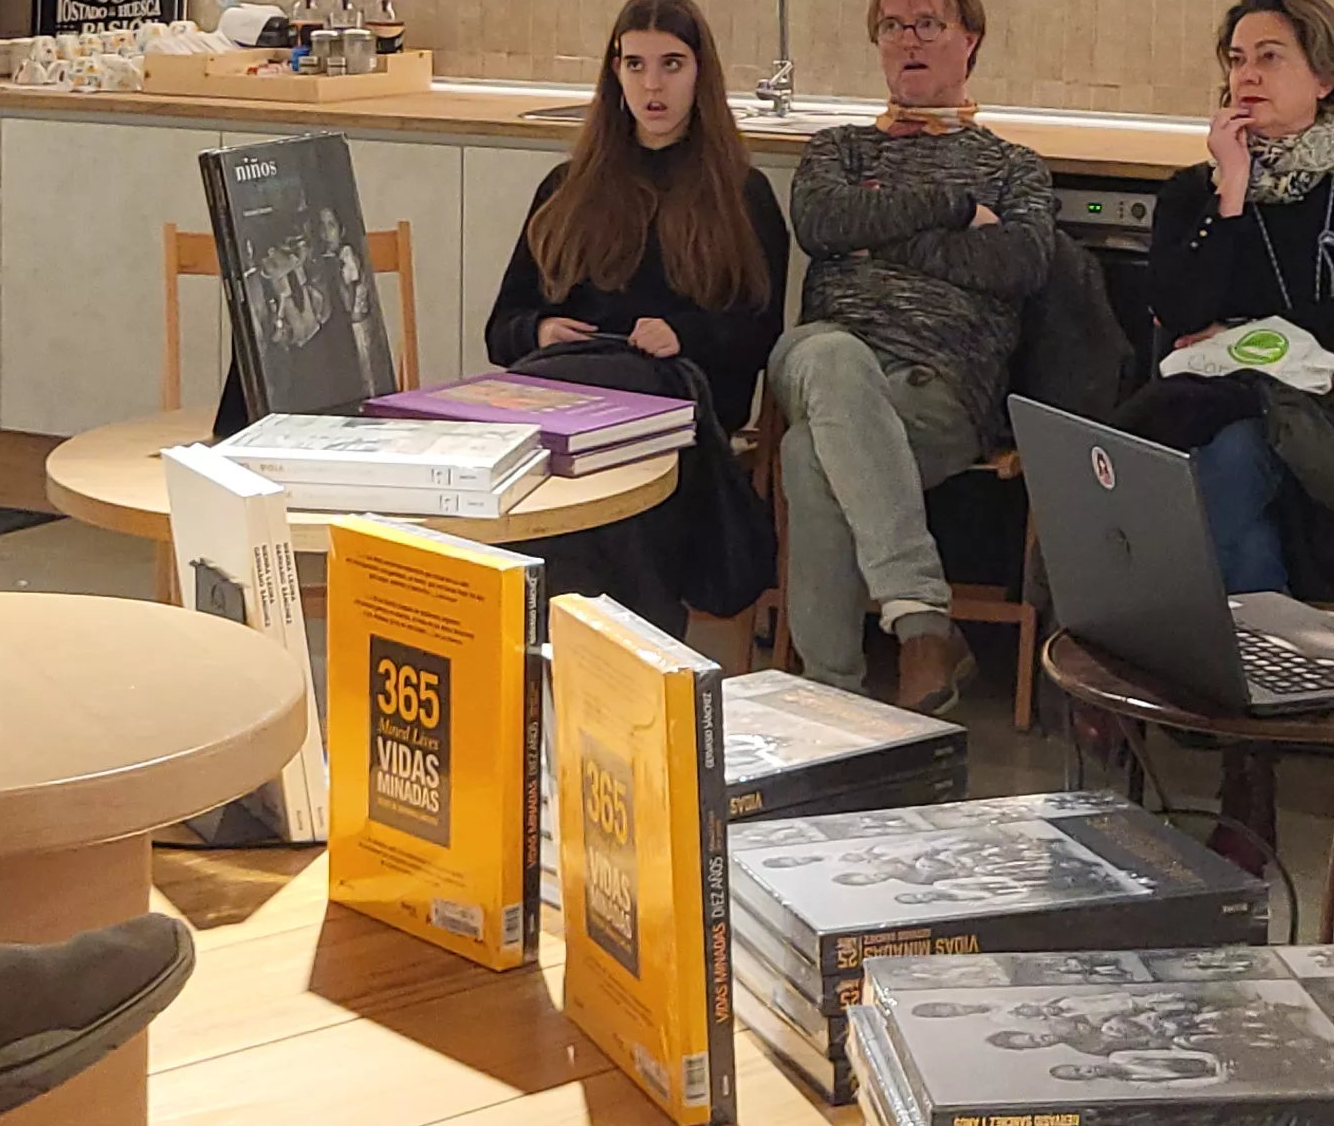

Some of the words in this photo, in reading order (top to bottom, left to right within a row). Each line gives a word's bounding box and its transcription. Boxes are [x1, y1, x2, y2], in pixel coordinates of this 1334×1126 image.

[234, 157, 278, 182] niños
[377, 657, 440, 729] 365
[376, 736, 441, 789] VIDAS
[377, 770, 441, 813] MINADAS
[586, 761, 628, 846] 365
[588, 845, 631, 912] VIDAS
[708, 856, 723, 886] AÑOS
[710, 889, 725, 919] DIEZ
[713, 922, 727, 984] MINADAS
[836, 950, 859, 969] 25
[935, 934, 980, 954] VIDAS
[715, 985, 729, 1024] VIDAS
